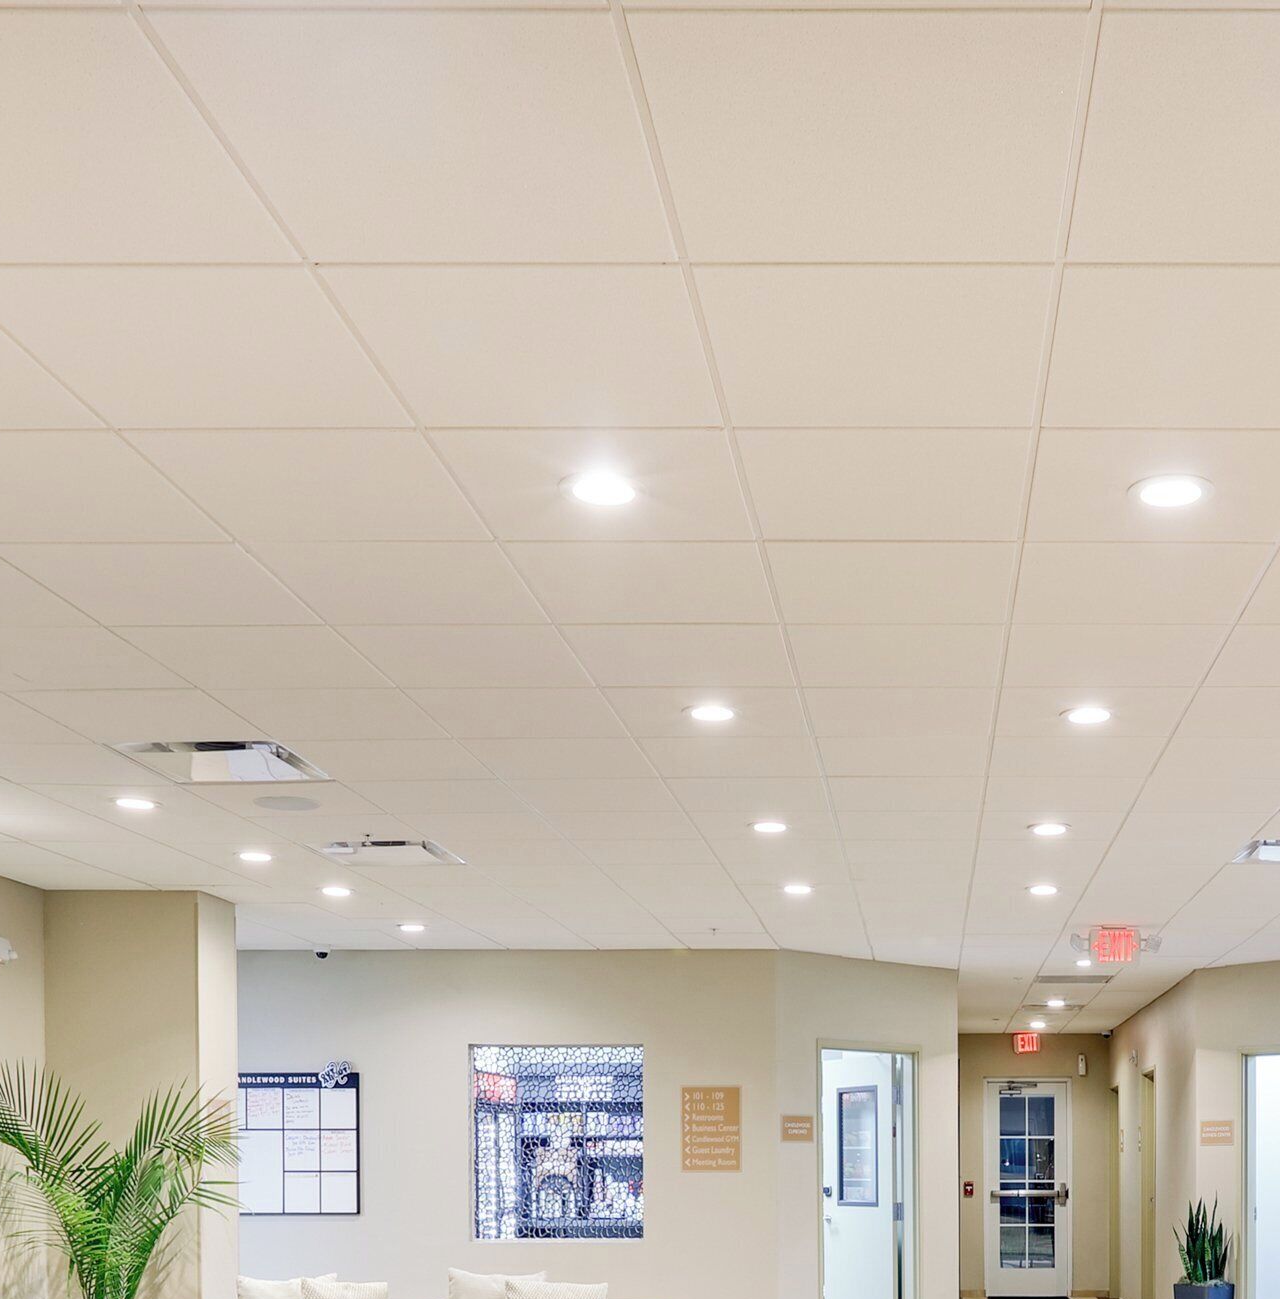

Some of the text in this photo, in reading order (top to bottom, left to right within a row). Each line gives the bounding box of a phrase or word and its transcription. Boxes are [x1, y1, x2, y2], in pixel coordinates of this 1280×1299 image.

[1099, 931, 1134, 961] EXIT
[1018, 1034, 1037, 1051] EXIT
[238, 1076, 317, 1084] ANDLEWOOD SUITES
[693, 1092, 704, 1100] 101
[693, 1102, 705, 1111] 110
[692, 1113, 724, 1121] Restrooms
[692, 1123, 739, 1132] Business Center
[692, 1135, 725, 1143] Candlewood
[692, 1146, 735, 1156] Guest Laundry
[692, 1158, 736, 1167] Meeting Room
